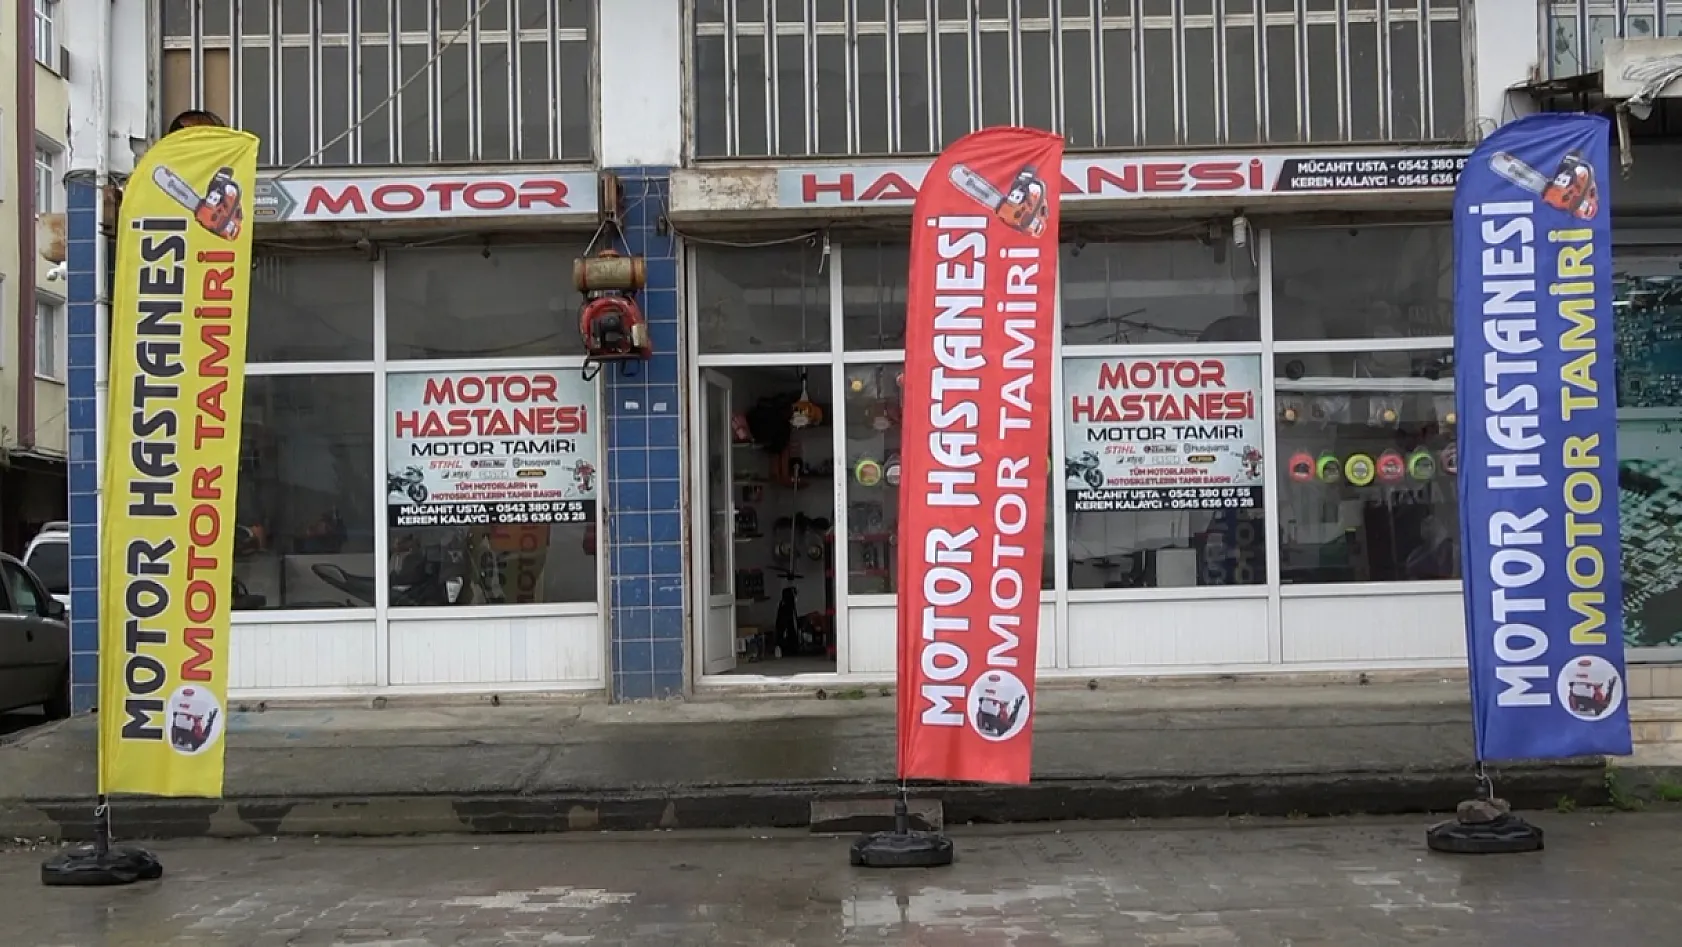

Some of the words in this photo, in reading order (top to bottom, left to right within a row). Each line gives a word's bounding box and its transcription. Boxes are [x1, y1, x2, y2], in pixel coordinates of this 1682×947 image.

[802, 158, 1263, 202] HANESİ
[1291, 176, 1334, 188] KEREM
[1336, 175, 1388, 187] KALAYCI
[1398, 174, 1429, 186] 0545
[1431, 173, 1454, 185] 636
[1356, 161, 1388, 172] USTA
[1398, 159, 1429, 171] 0542
[1431, 158, 1454, 171] 380
[303, 180, 571, 214] MOTOR
[996, 247, 1041, 440] TAMİRİ
[1548, 228, 1600, 422] TAMİRİ
[194, 250, 236, 450] TAMİRİ
[926, 216, 988, 506] HASTANESİ
[1468, 200, 1549, 490] HASTANESİ
[128, 217, 189, 517] HASTANESİ
[1097, 359, 1227, 390] MOTOR
[423, 375, 558, 405] MOTOR
[411, 441, 494, 457] MOTOR
[1087, 427, 1166, 442] MOTOR
[1104, 445, 1136, 454] STIHL
[429, 460, 463, 469] STIHL
[456, 504, 486, 513] USTA
[496, 503, 526, 512] 0542
[528, 502, 550, 512] 380
[552, 502, 566, 512] 87
[568, 501, 583, 511] 55
[1075, 500, 1113, 510] KEREM
[1115, 500, 1162, 509] KALAYCI
[1171, 499, 1200, 509] 0545
[1201, 499, 1222, 508] 636
[1224, 498, 1239, 508] 03
[1239, 498, 1255, 508] 28
[1130, 489, 1160, 499] USTA
[1168, 489, 1197, 498] 0542
[1199, 488, 1219, 498] 380
[1236, 488, 1251, 497] 55
[397, 515, 438, 526] KEREM
[441, 514, 489, 524] KALAYCI
[499, 513, 529, 523] 0545
[531, 512, 552, 522] 636
[554, 512, 570, 521] 03
[571, 511, 586, 521] 28
[1562, 433, 1607, 646] MOTOR
[180, 465, 223, 682] MOTOR
[986, 456, 1030, 667] MOTOR
[921, 526, 980, 726] MOTOR
[1489, 507, 1551, 707] MOTOR
[121, 537, 177, 740] MOTOR
